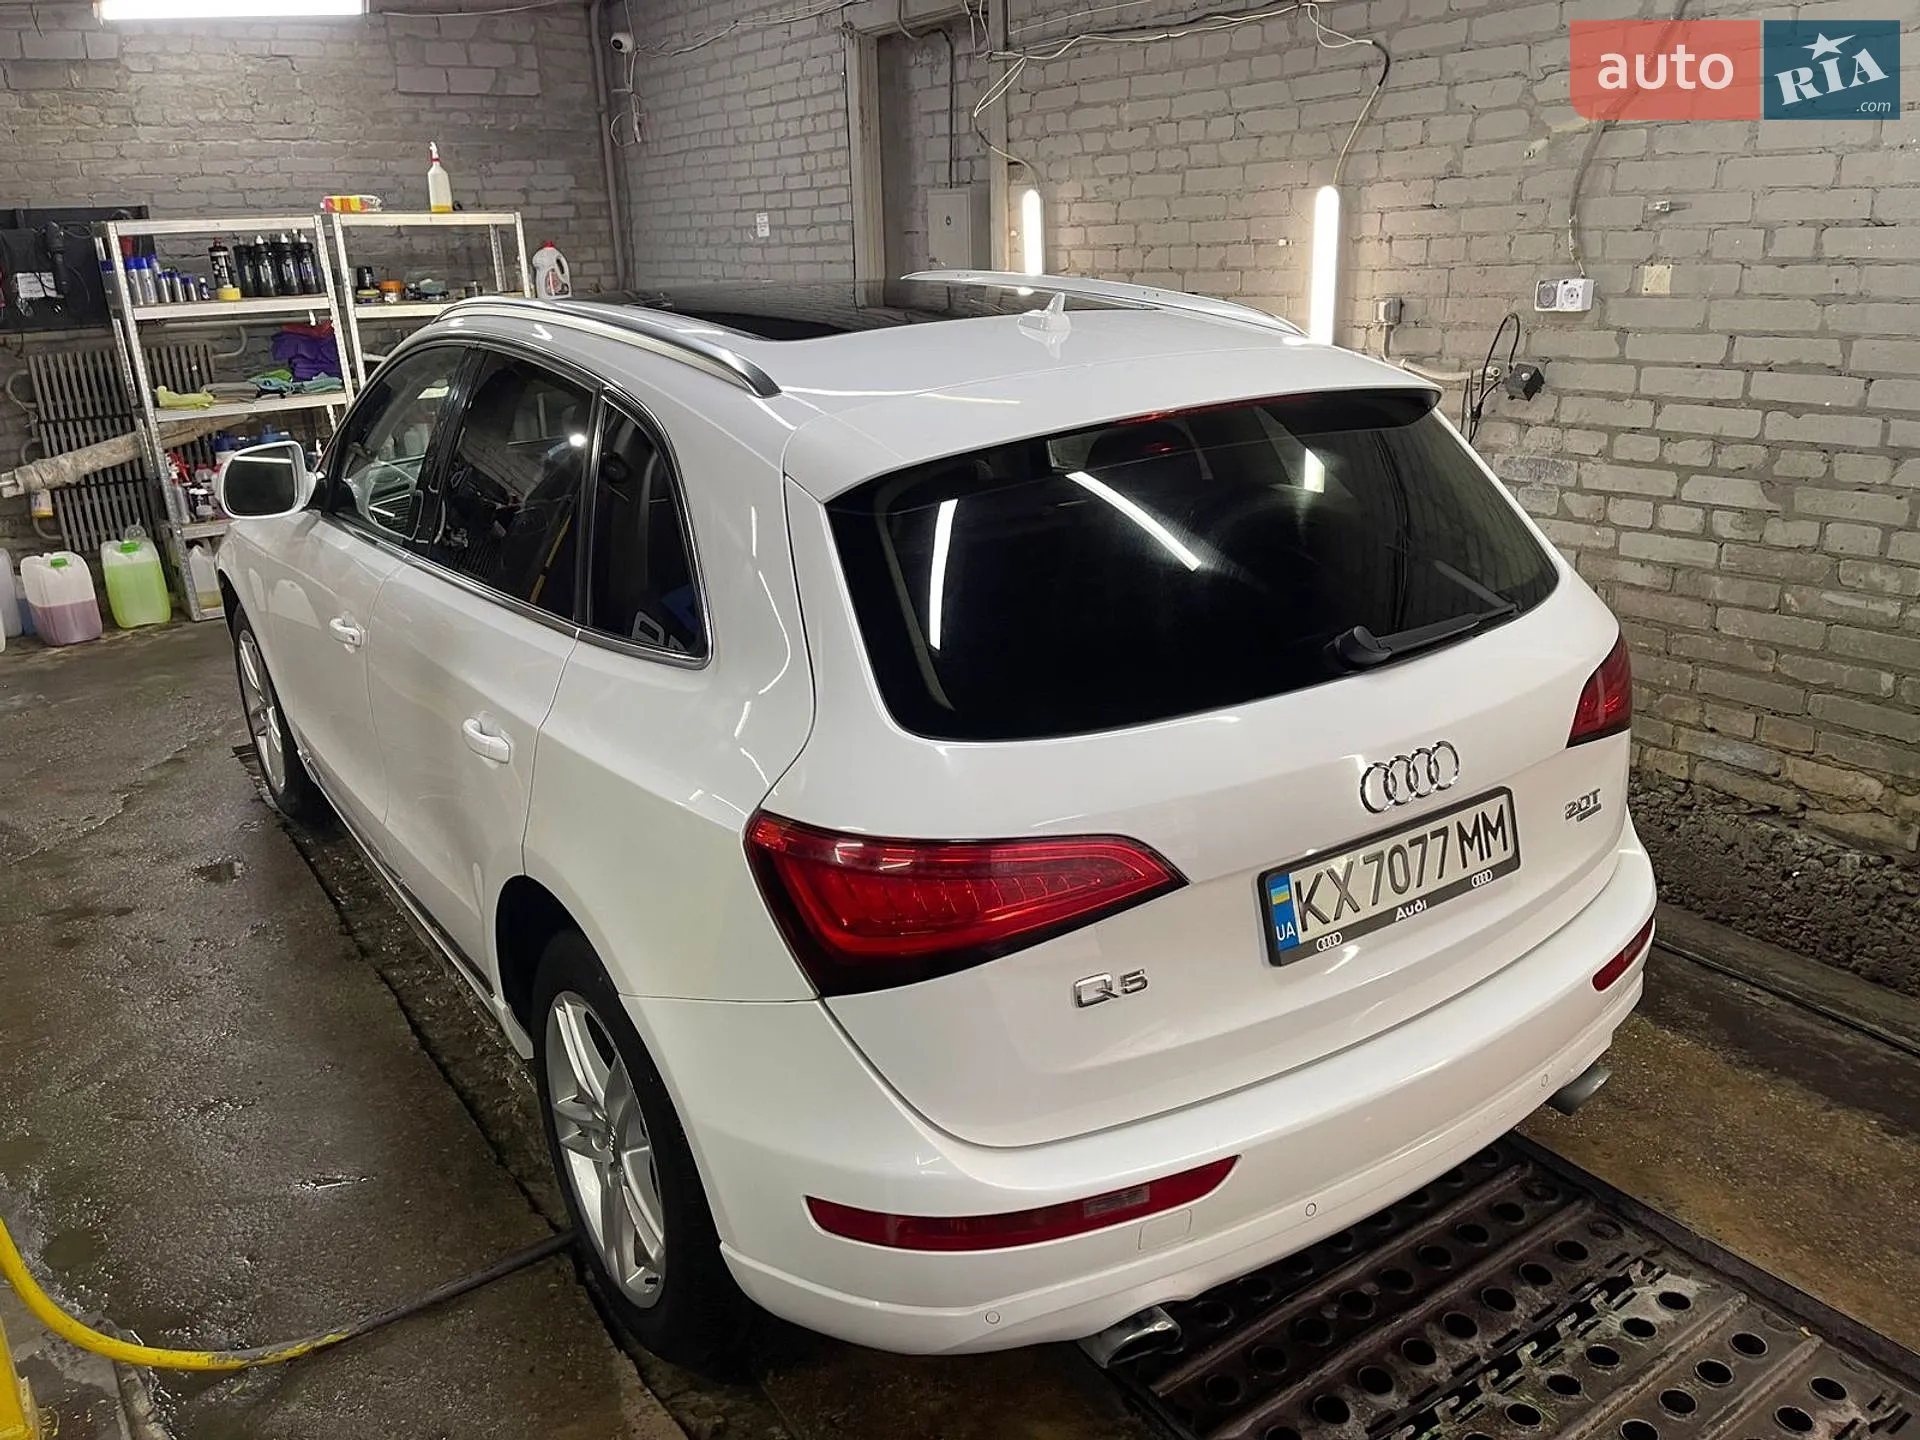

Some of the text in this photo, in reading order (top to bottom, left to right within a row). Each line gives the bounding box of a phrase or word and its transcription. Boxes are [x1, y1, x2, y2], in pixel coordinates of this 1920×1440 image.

[1294, 804, 1509, 932] KX 7077 MM
[1395, 899, 1428, 922] Audi
[1275, 921, 1296, 941] UA
[1072, 968, 1148, 1008] Q5
